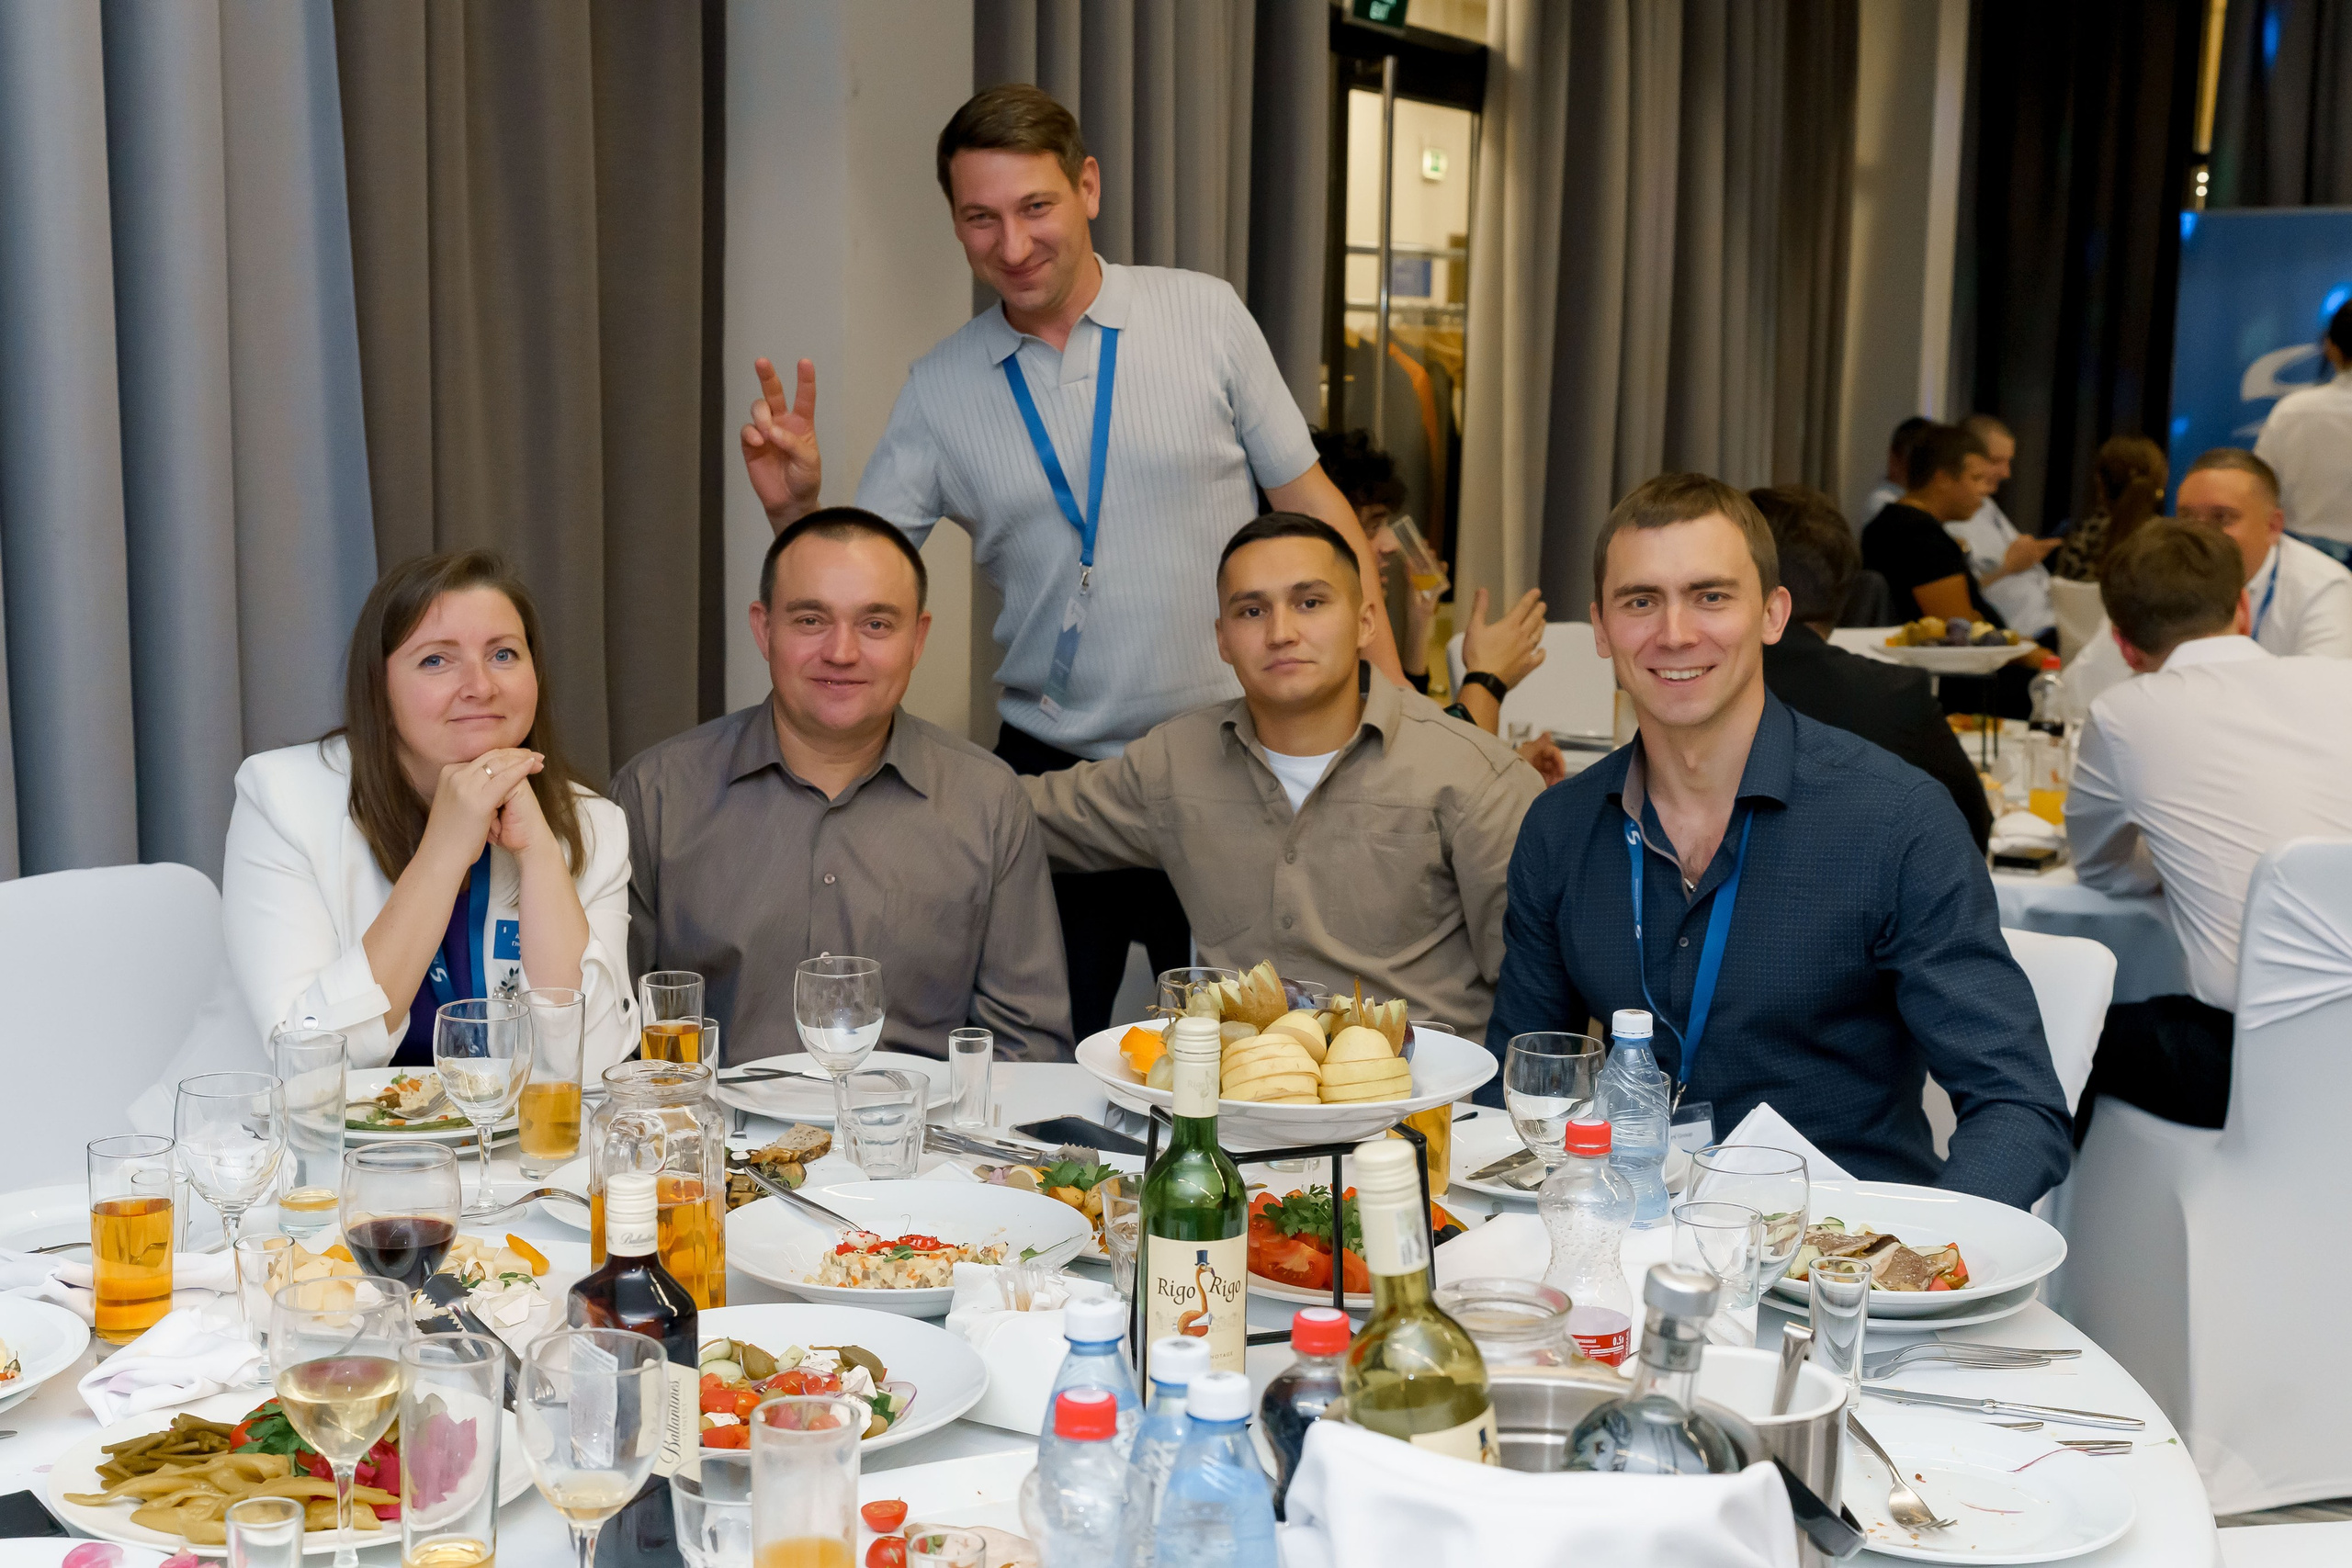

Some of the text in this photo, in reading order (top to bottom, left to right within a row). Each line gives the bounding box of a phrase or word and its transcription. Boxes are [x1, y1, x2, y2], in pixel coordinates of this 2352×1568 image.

[1158, 1276, 1240, 1305] Rigo Rigo
[1210, 1351, 1233, 1359] NOTAGE
